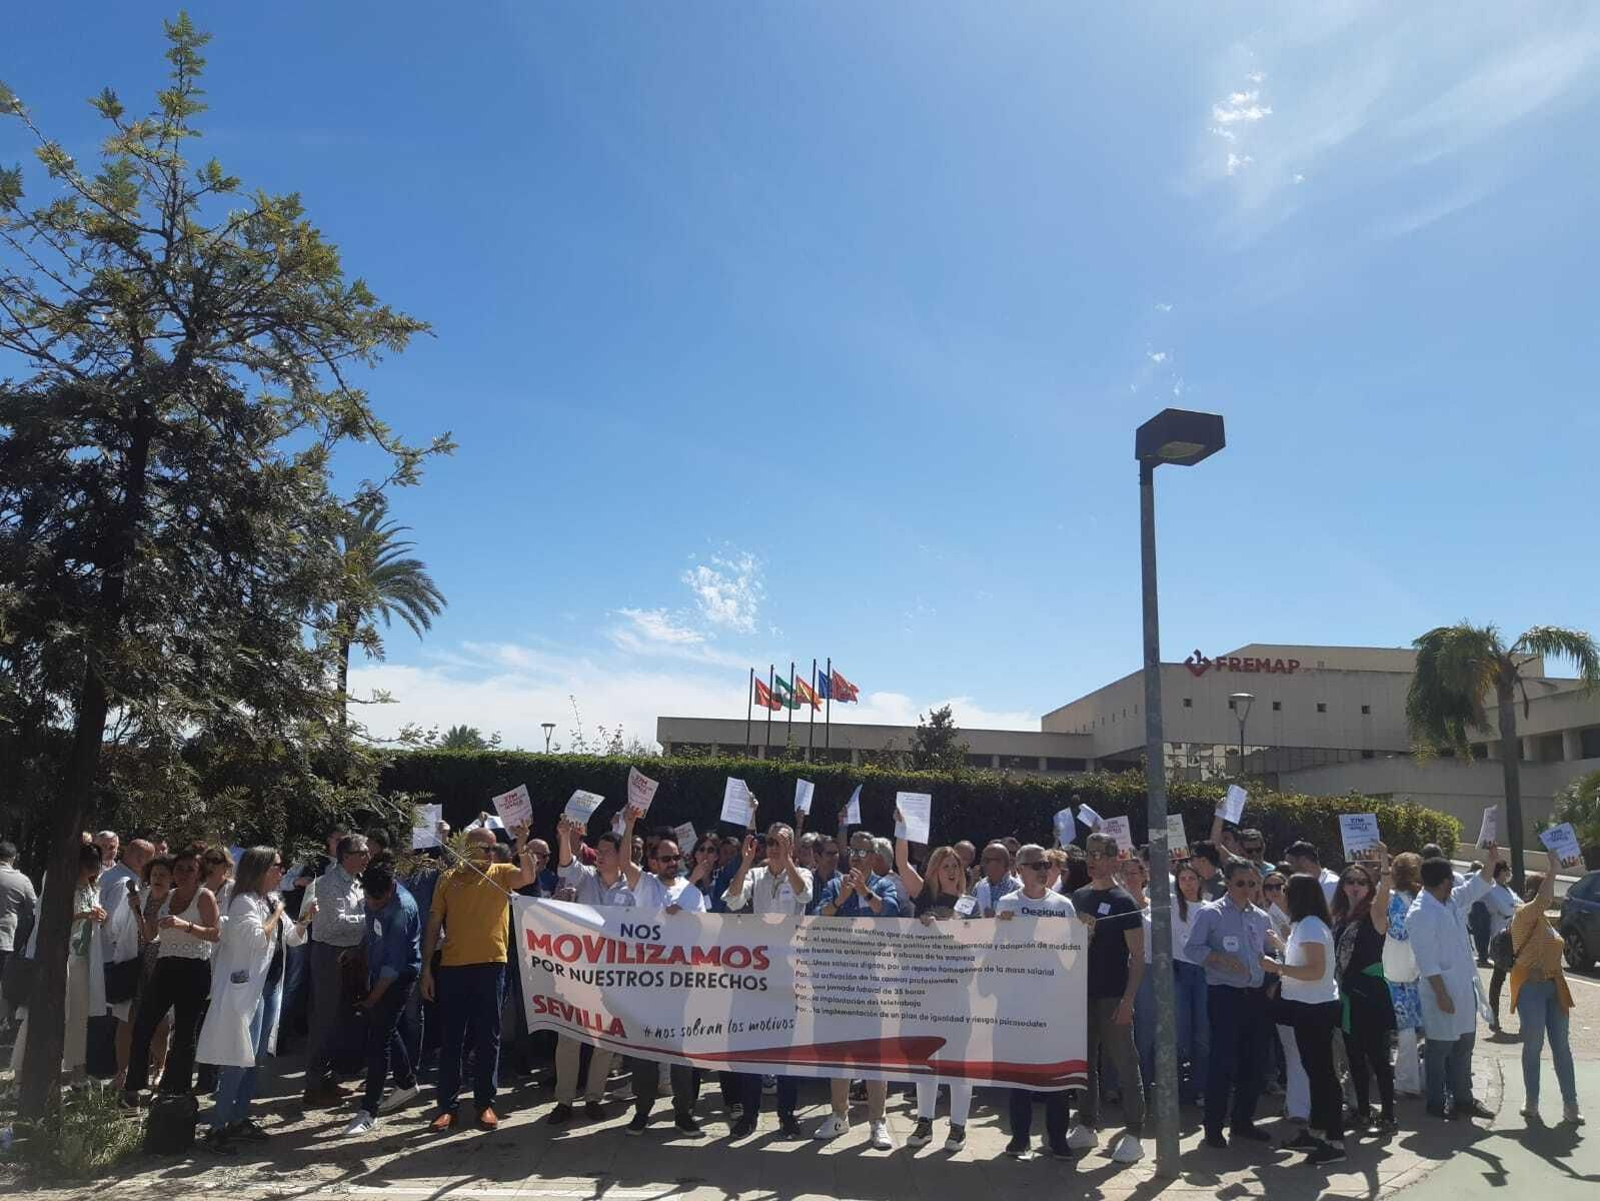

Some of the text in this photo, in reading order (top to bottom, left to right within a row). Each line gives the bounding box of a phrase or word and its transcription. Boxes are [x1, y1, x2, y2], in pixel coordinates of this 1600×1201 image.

[1216, 656, 1300, 674] FREMAP
[1021, 906, 1066, 918] Desigual
[620, 924, 661, 940] NOS
[526, 928, 769, 970] MOVILIZAMOS
[1000, 942, 1035, 951] adopción
[532, 956, 768, 991] POR NUESTROS DERECHOS
[821, 972, 857, 981] activación
[880, 999, 921, 1008] teletrabajo
[533, 995, 627, 1038] SEVILLA
[822, 1008, 877, 1018] implementación
[902, 1011, 917, 1019] plan
[931, 1014, 964, 1023] igualdad
[999, 1018, 1046, 1028] psicosociales
[680, 1018, 722, 1037] sobran
[728, 1017, 743, 1033] los
[748, 1015, 794, 1033] motivos
